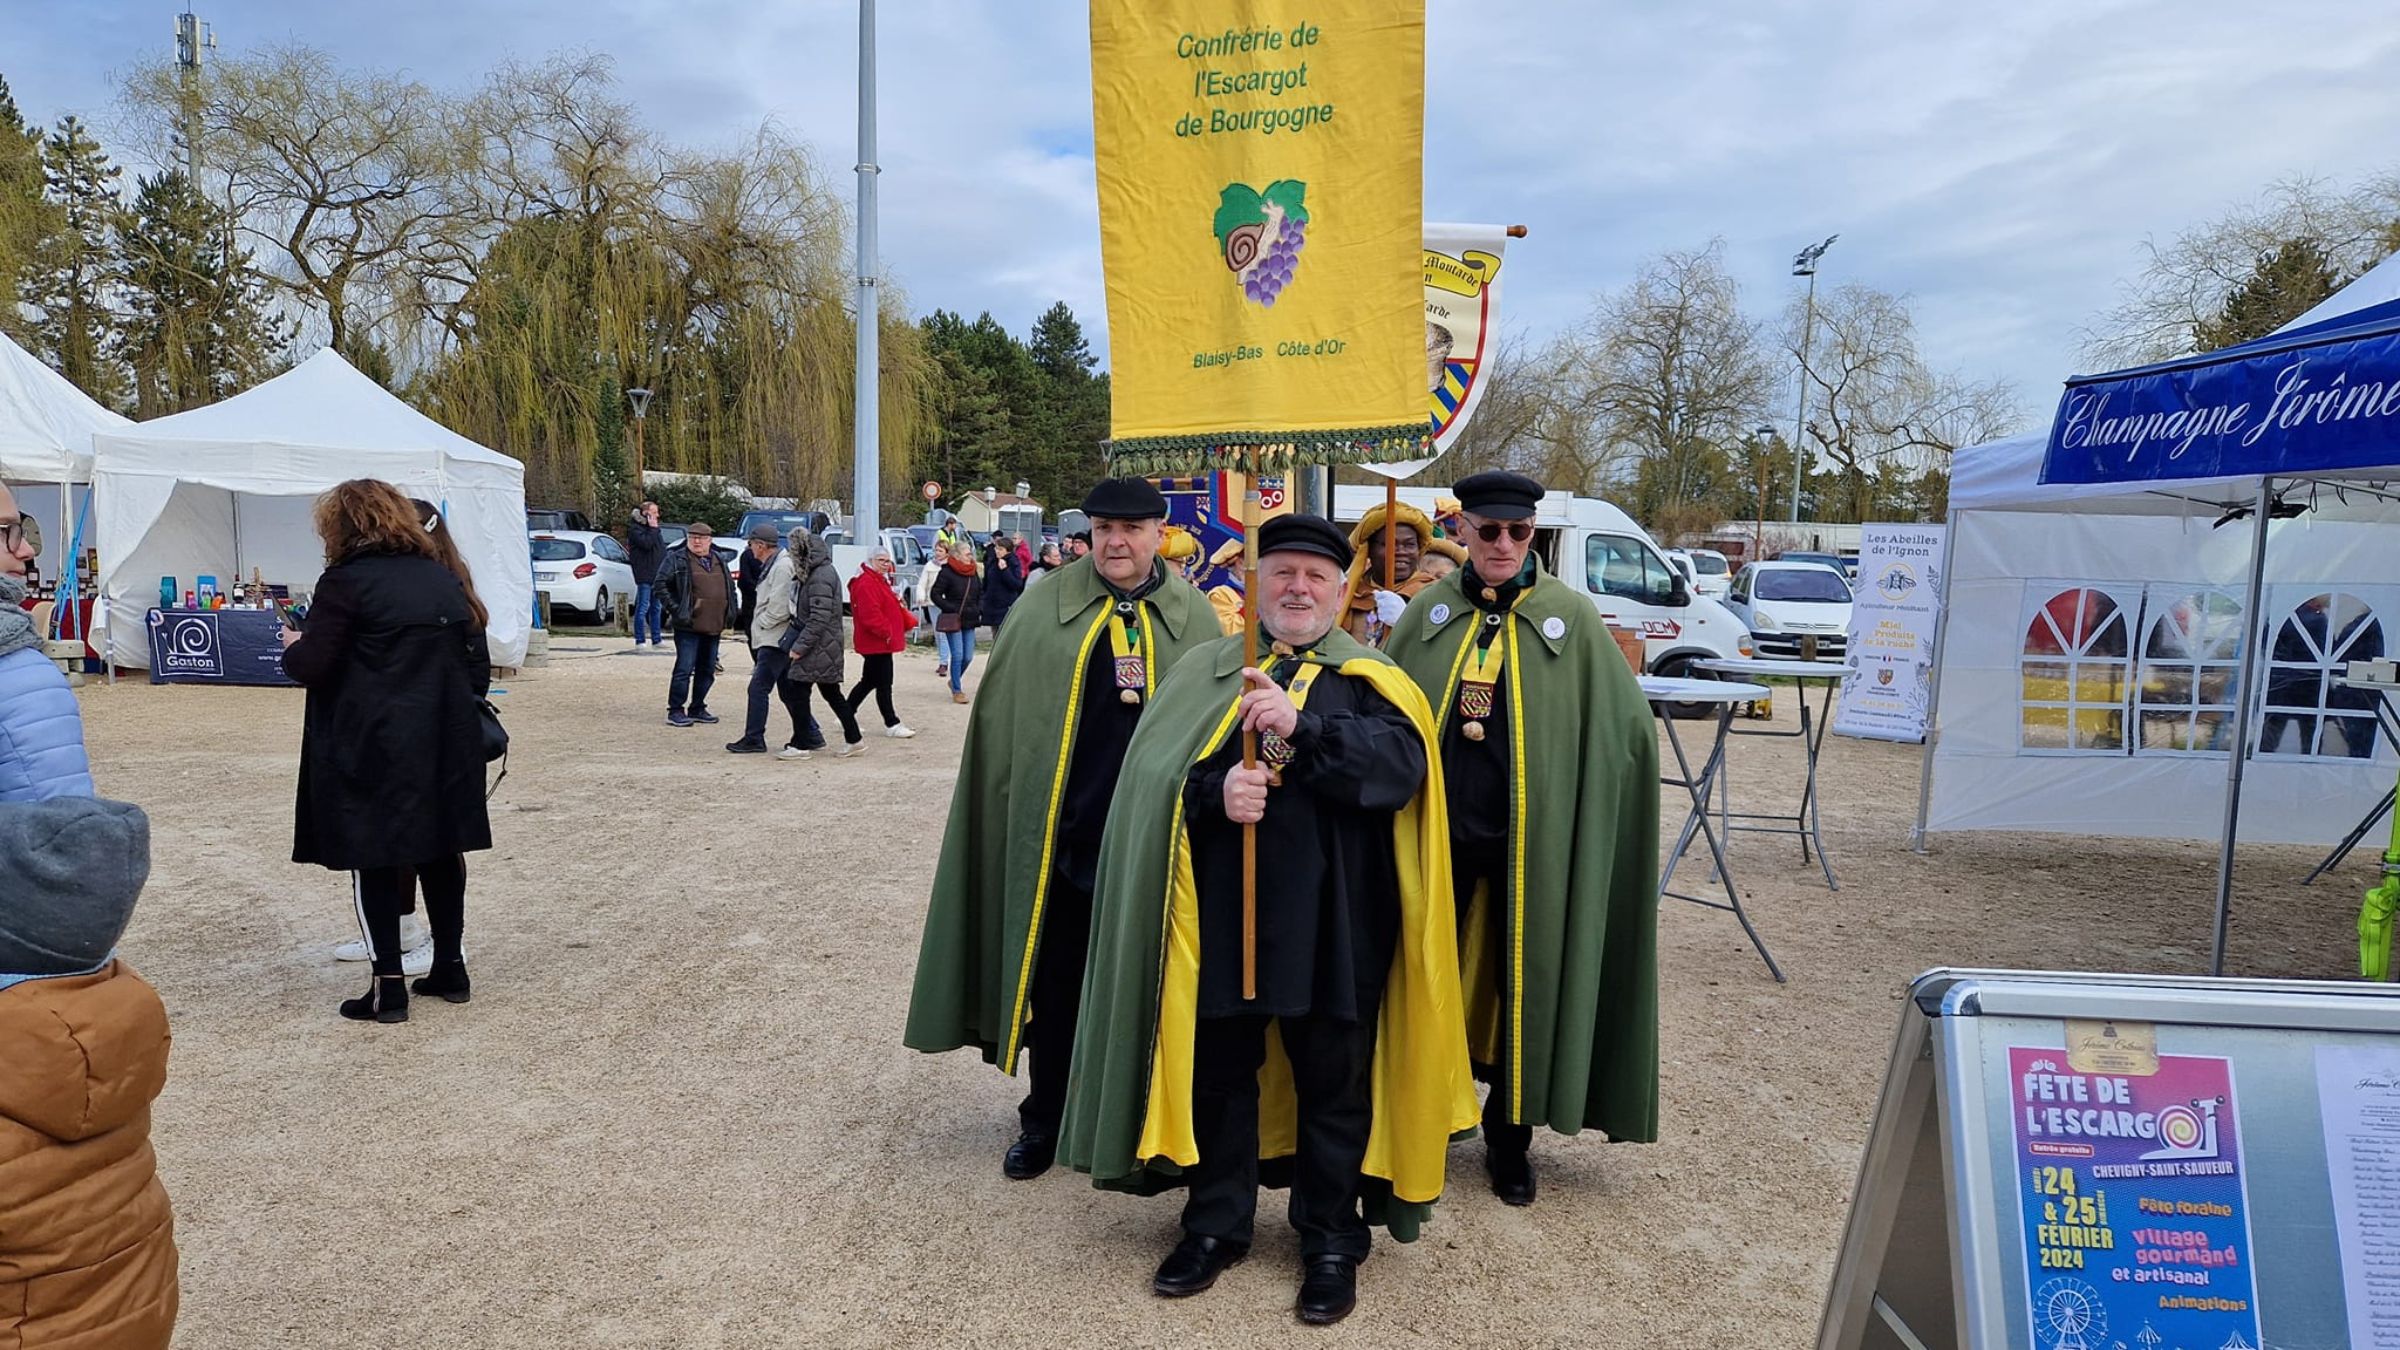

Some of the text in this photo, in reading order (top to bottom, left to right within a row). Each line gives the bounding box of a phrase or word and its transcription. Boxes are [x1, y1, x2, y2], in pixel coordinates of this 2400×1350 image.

[1177, 20, 1319, 58] Confrérie de
[1195, 61, 1307, 97] l'Escargot
[1175, 103, 1333, 138] de Bourgogne
[1424, 256, 1478, 286] Moutarde
[1425, 300, 1451, 319] arde
[1193, 339, 1346, 368] Blaisy-Bas Côte d'Or
[2062, 358, 2400, 462] Champagne Jérôme
[1867, 534, 1938, 545] Les Abeilles
[1871, 545, 1930, 557] de l'Ignon
[166, 656, 214, 668] Gaston
[2095, 1076, 2130, 1104] DE
[2043, 1166, 2075, 1195] 24
[2092, 1161, 2234, 1178] CHEVIGNY-SAINT-SAUVEUR
[2044, 1201, 2057, 1221] &
[2062, 1196, 2096, 1225] 25
[2176, 1201, 2232, 1217] foraine
[2038, 1221, 2113, 1249] FÉVRIER
[2040, 1247, 2083, 1268] 2024
[2136, 1245, 2237, 1266] gourmand
[2112, 1268, 2210, 1285] et artisanal
[2159, 1295, 2247, 1311] Animations
